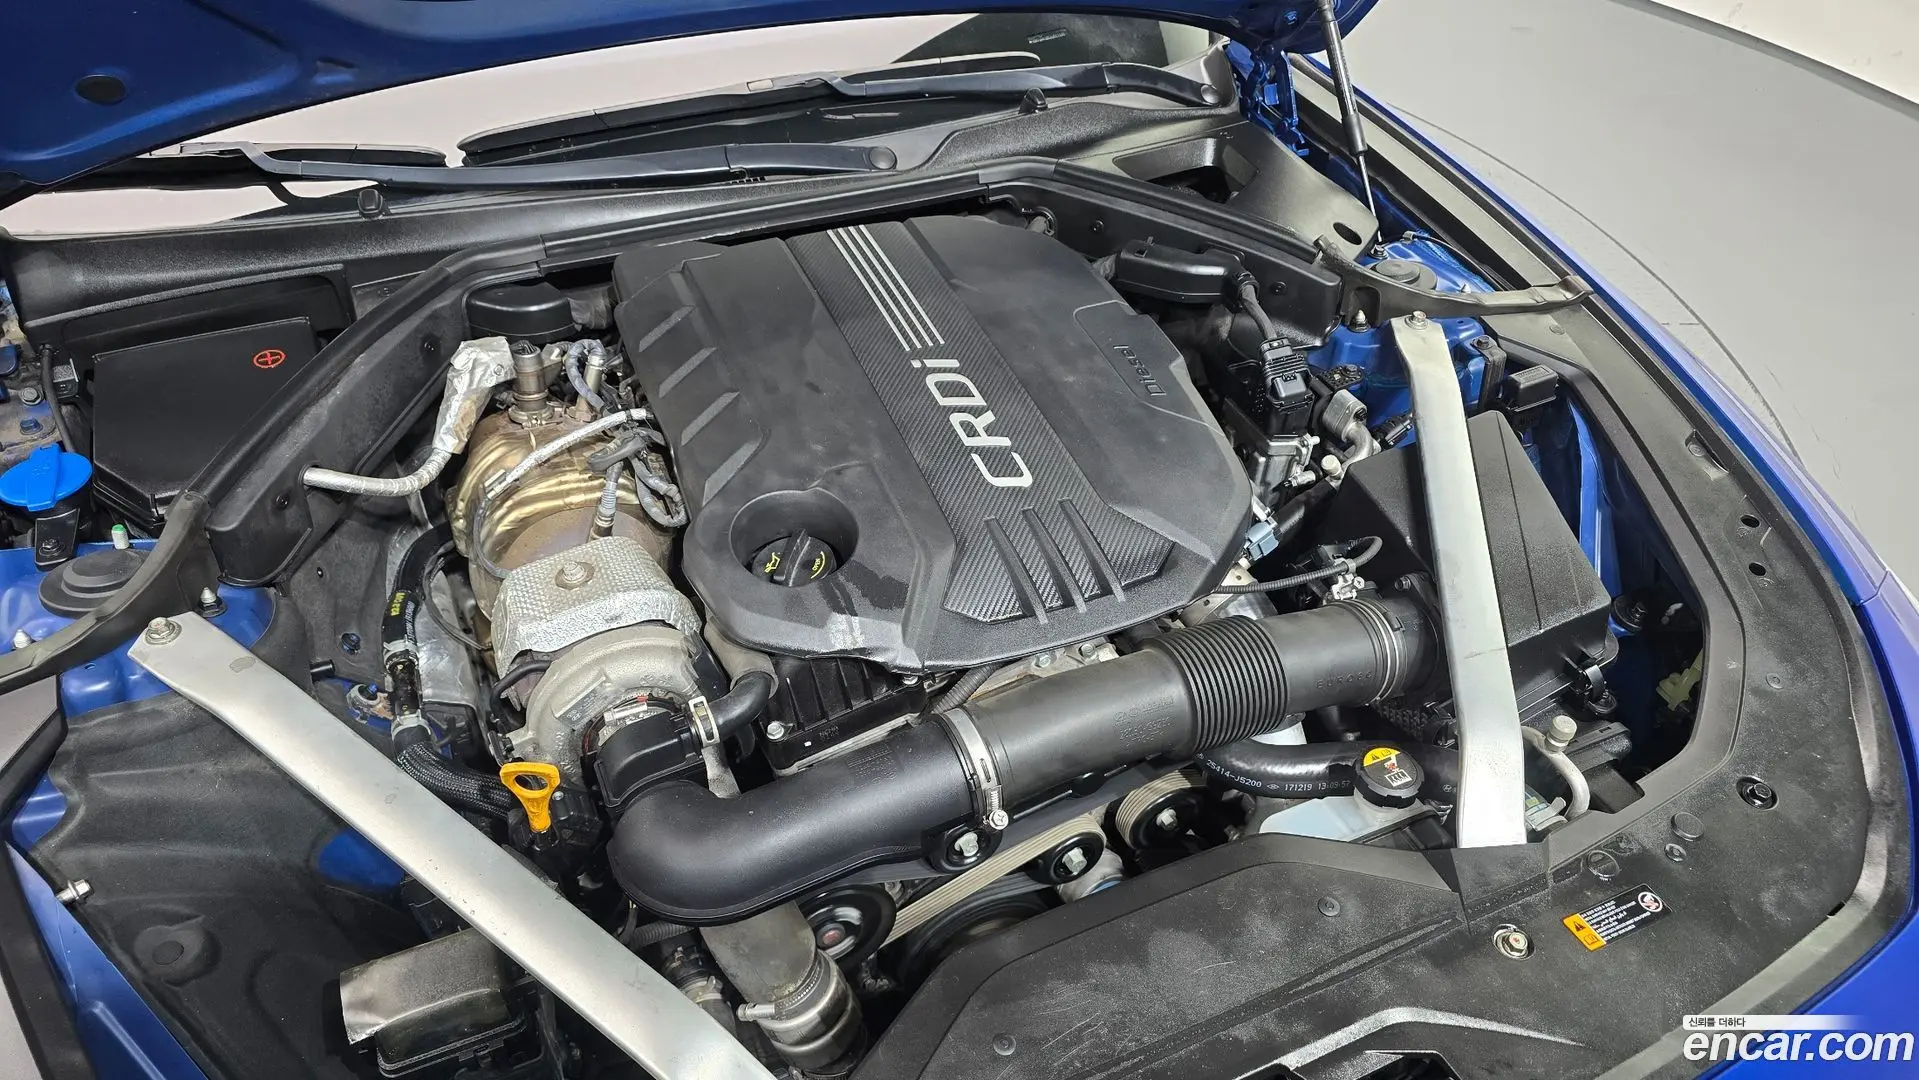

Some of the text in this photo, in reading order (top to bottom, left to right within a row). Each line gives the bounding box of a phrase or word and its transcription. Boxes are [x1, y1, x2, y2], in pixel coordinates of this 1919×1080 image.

[1113, 345, 1167, 396] Diesel
[910, 358, 1033, 487] CRDi
[811, 557, 822, 571] OPEN
[1206, 759, 1262, 788] 25414-J5200
[1284, 783, 1313, 792] 171219
